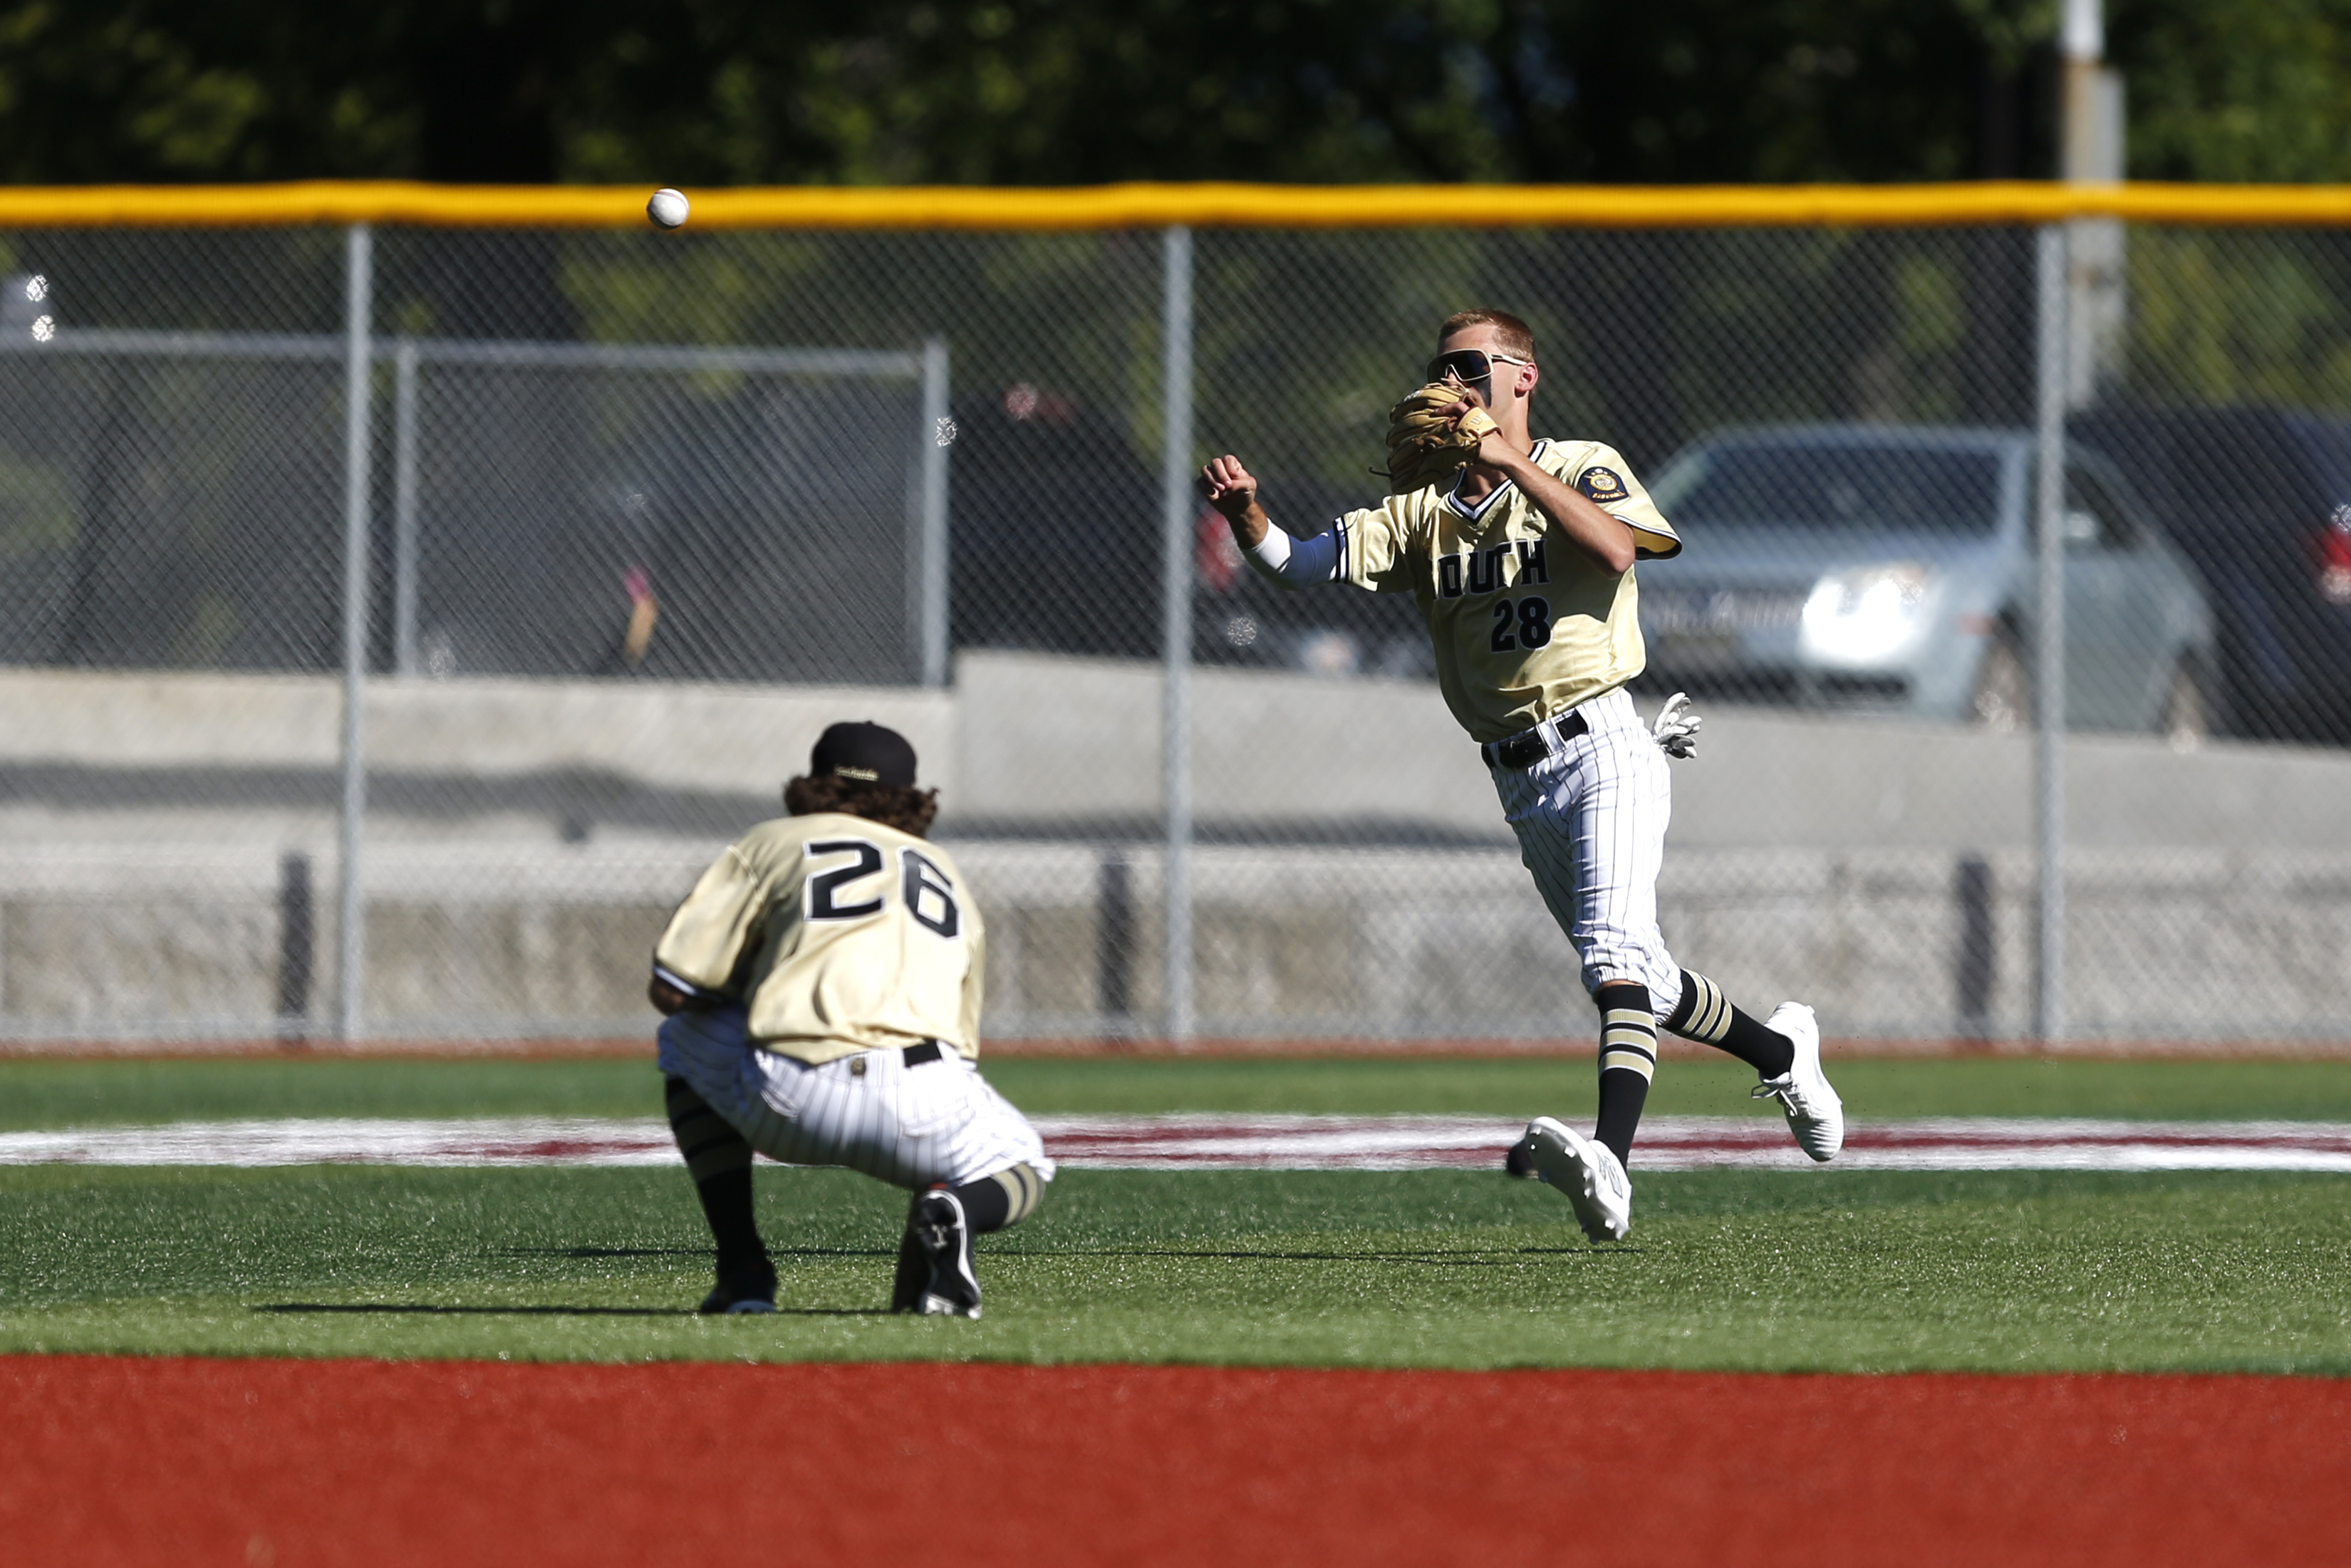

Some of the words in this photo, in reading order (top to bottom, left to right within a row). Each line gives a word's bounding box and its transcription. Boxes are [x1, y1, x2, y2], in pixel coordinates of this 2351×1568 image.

[1431, 538, 1551, 601] OUTH
[1490, 596, 1553, 653] 28
[802, 838, 962, 940] 26
